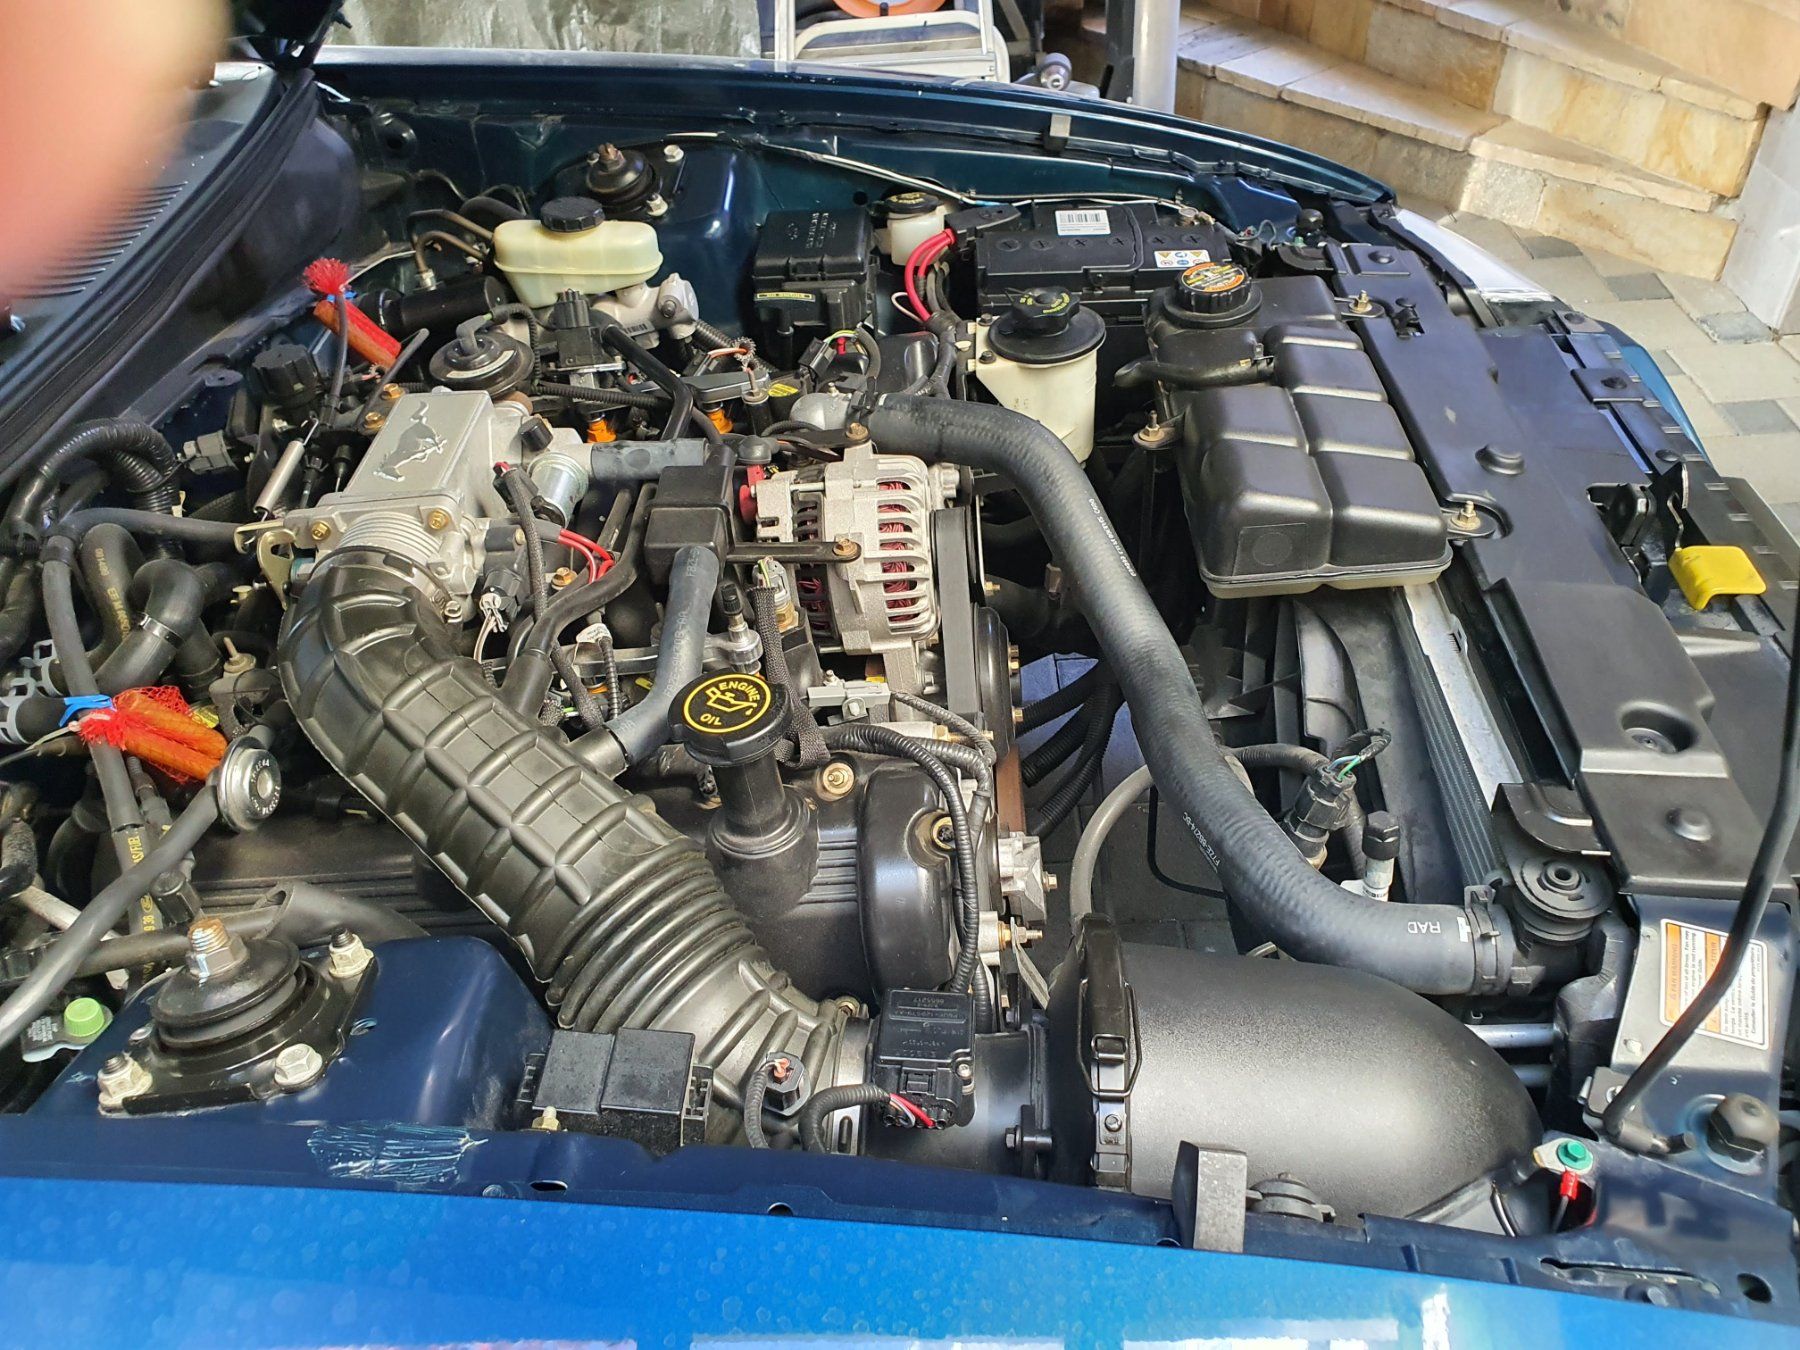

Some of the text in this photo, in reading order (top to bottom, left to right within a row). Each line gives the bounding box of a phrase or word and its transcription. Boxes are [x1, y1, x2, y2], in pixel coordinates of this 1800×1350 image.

[718, 680, 761, 702] ENGINE
[699, 713, 723, 726] OIL
[1407, 921, 1441, 934] RAD
